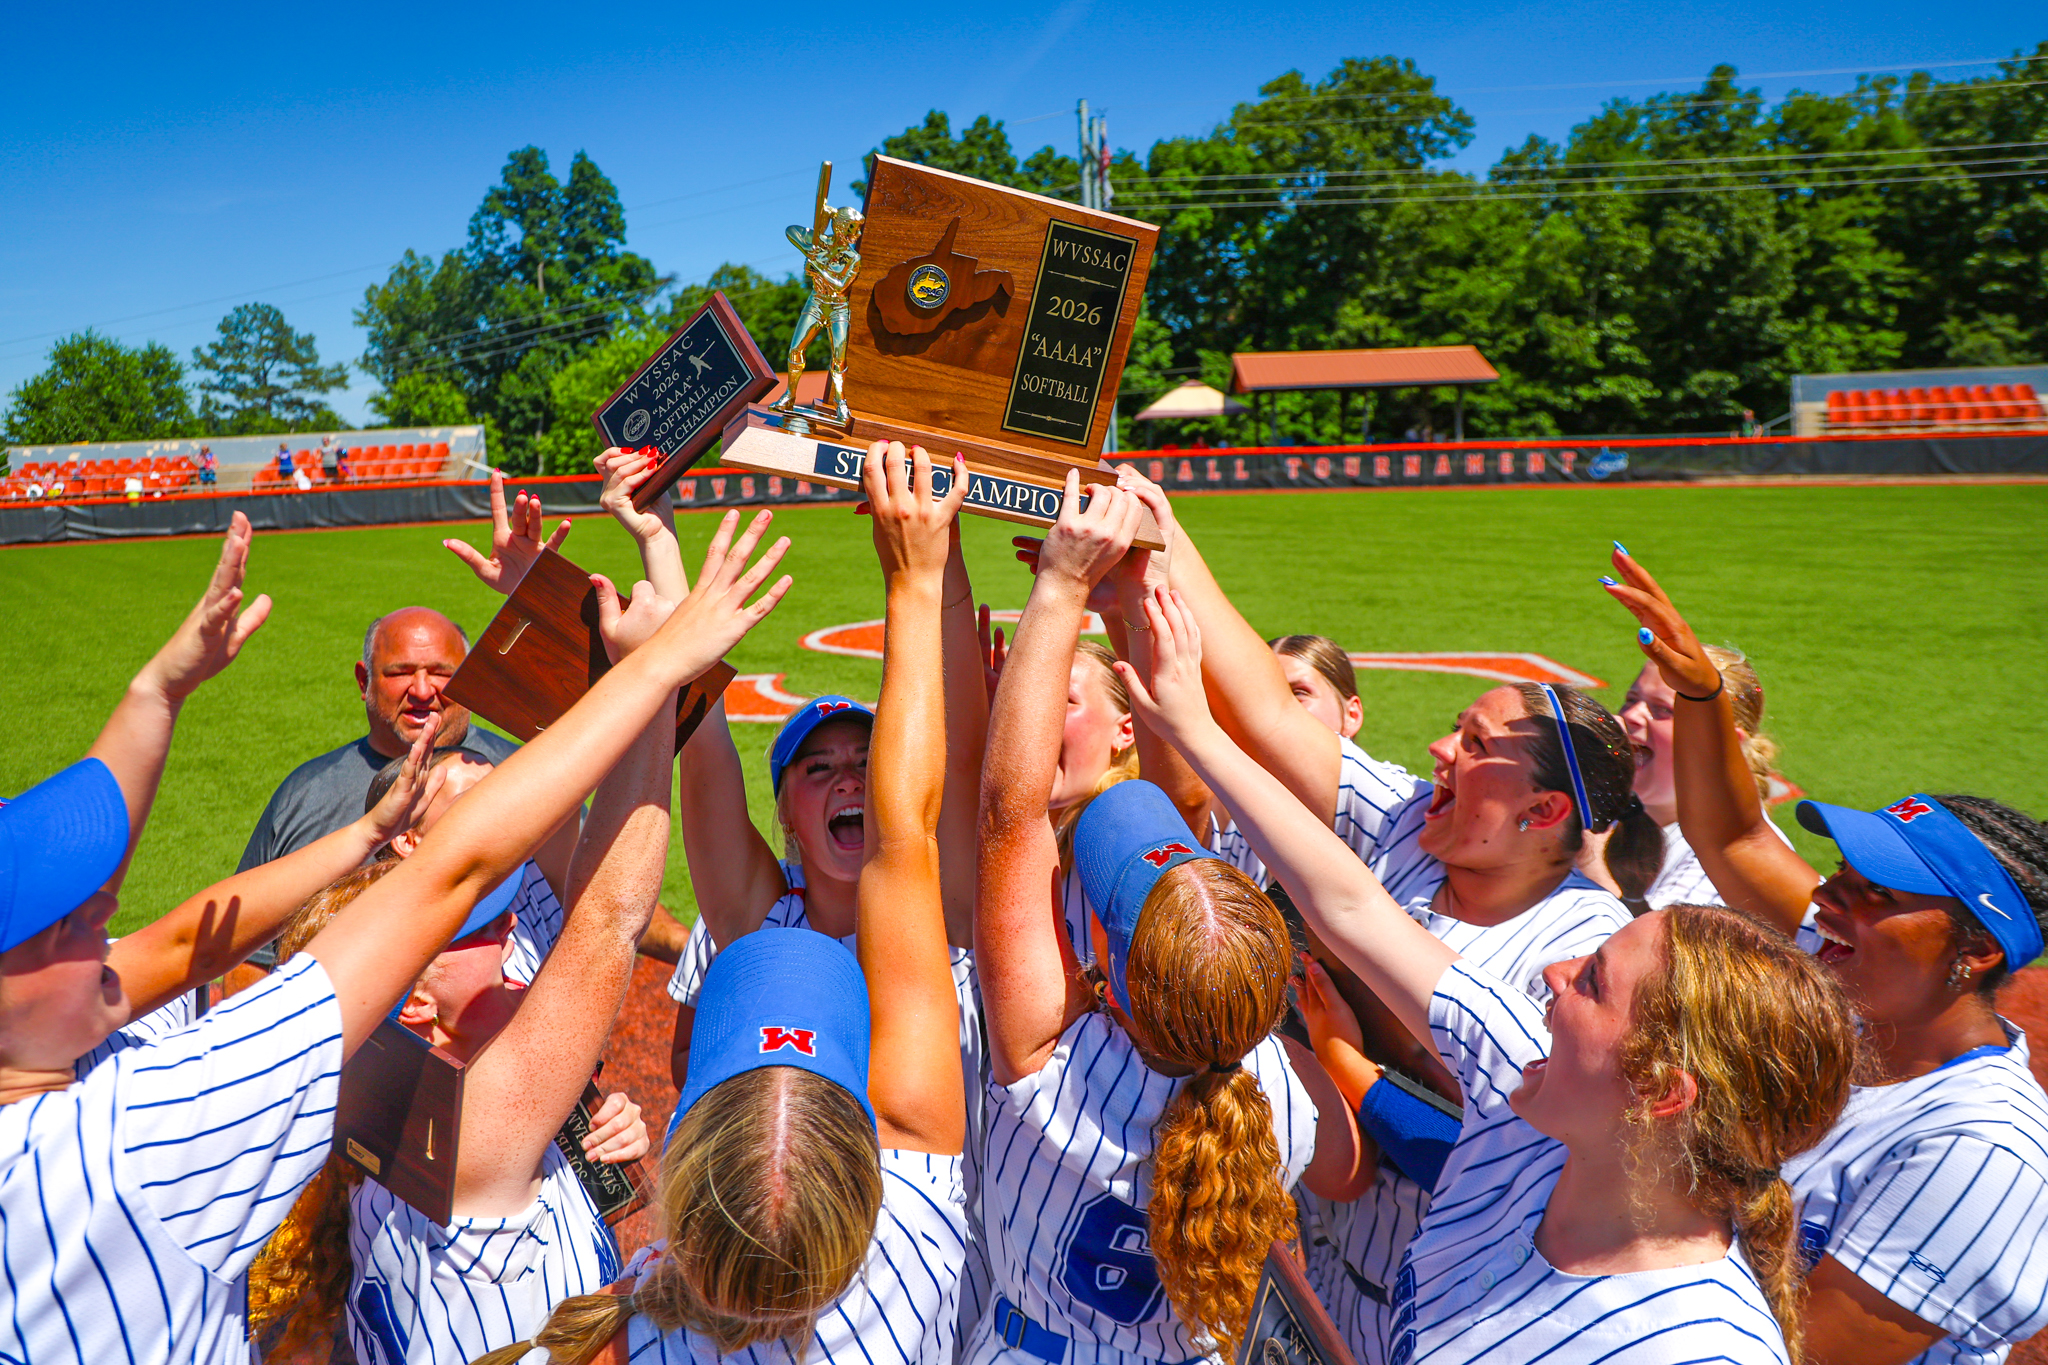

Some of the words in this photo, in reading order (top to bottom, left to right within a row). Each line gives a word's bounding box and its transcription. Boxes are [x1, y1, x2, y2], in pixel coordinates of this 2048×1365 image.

[1053, 238, 1126, 272] WVSSAC
[1046, 296, 1103, 326] 2026
[652, 368, 680, 400] 2026
[1021, 373, 1089, 404] SOFTBALL
[653, 383, 710, 441] SOFTBALL
[674, 375, 738, 440] CHAMPION
[1284, 450, 1579, 480] TOURNAMENT
[1883, 795, 1935, 824] M
